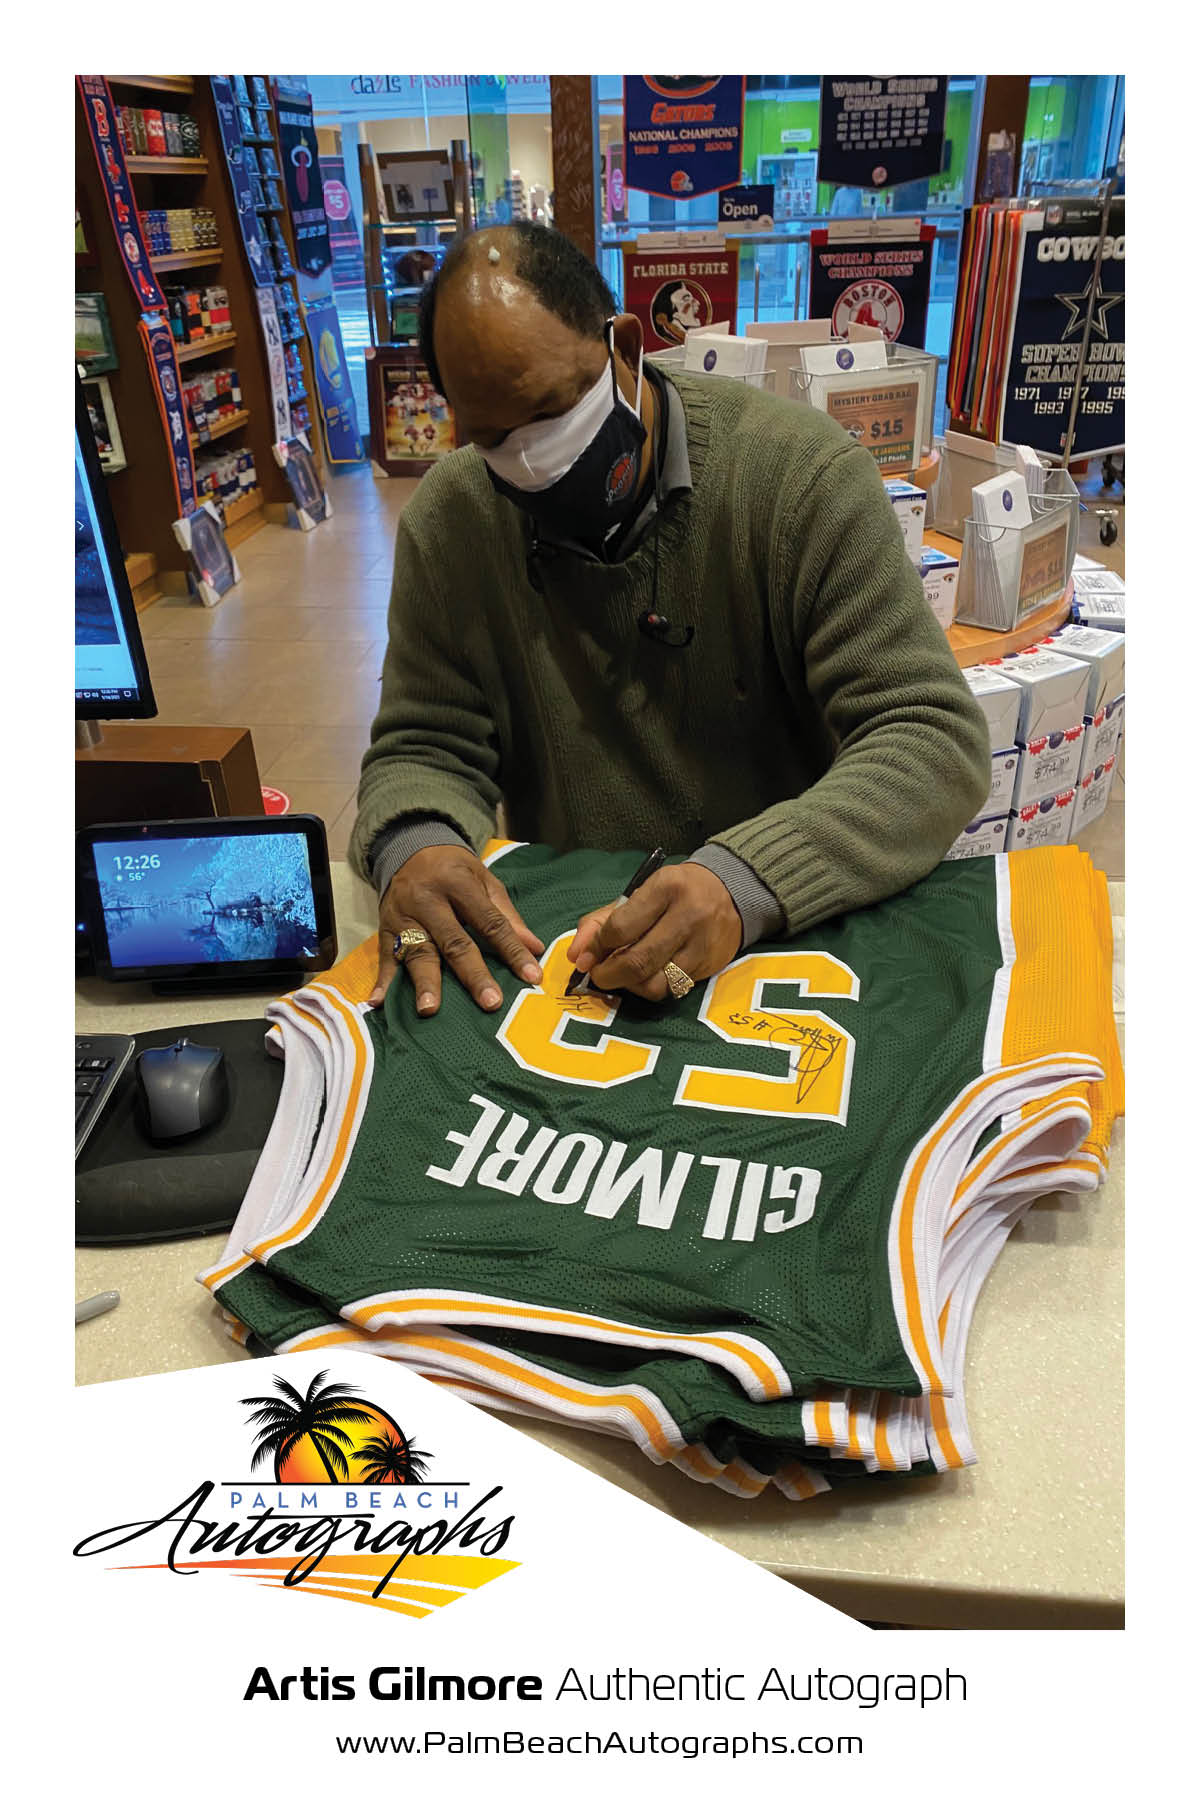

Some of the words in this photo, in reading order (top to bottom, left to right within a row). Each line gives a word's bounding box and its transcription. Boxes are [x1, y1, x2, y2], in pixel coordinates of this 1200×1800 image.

[629, 130, 678, 142] NATIONAL
[679, 127, 738, 140] CHAMPIONS
[723, 203, 758, 218] Open
[633, 264, 686, 278] FLORIDA
[689, 262, 728, 275] STATE
[843, 285, 897, 308] BOSTON
[1021, 344, 1081, 364] SUPER
[834, 396, 869, 406] MYSTERY
[1015, 387, 1040, 400] 1971
[1058, 386, 1089, 400] 197
[1034, 402, 1064, 414] 1993
[1081, 401, 1114, 414] 1995
[870, 418, 904, 440] $15
[112, 854, 161, 870] 12:26
[425, 1093, 823, 1243] GILMORE
